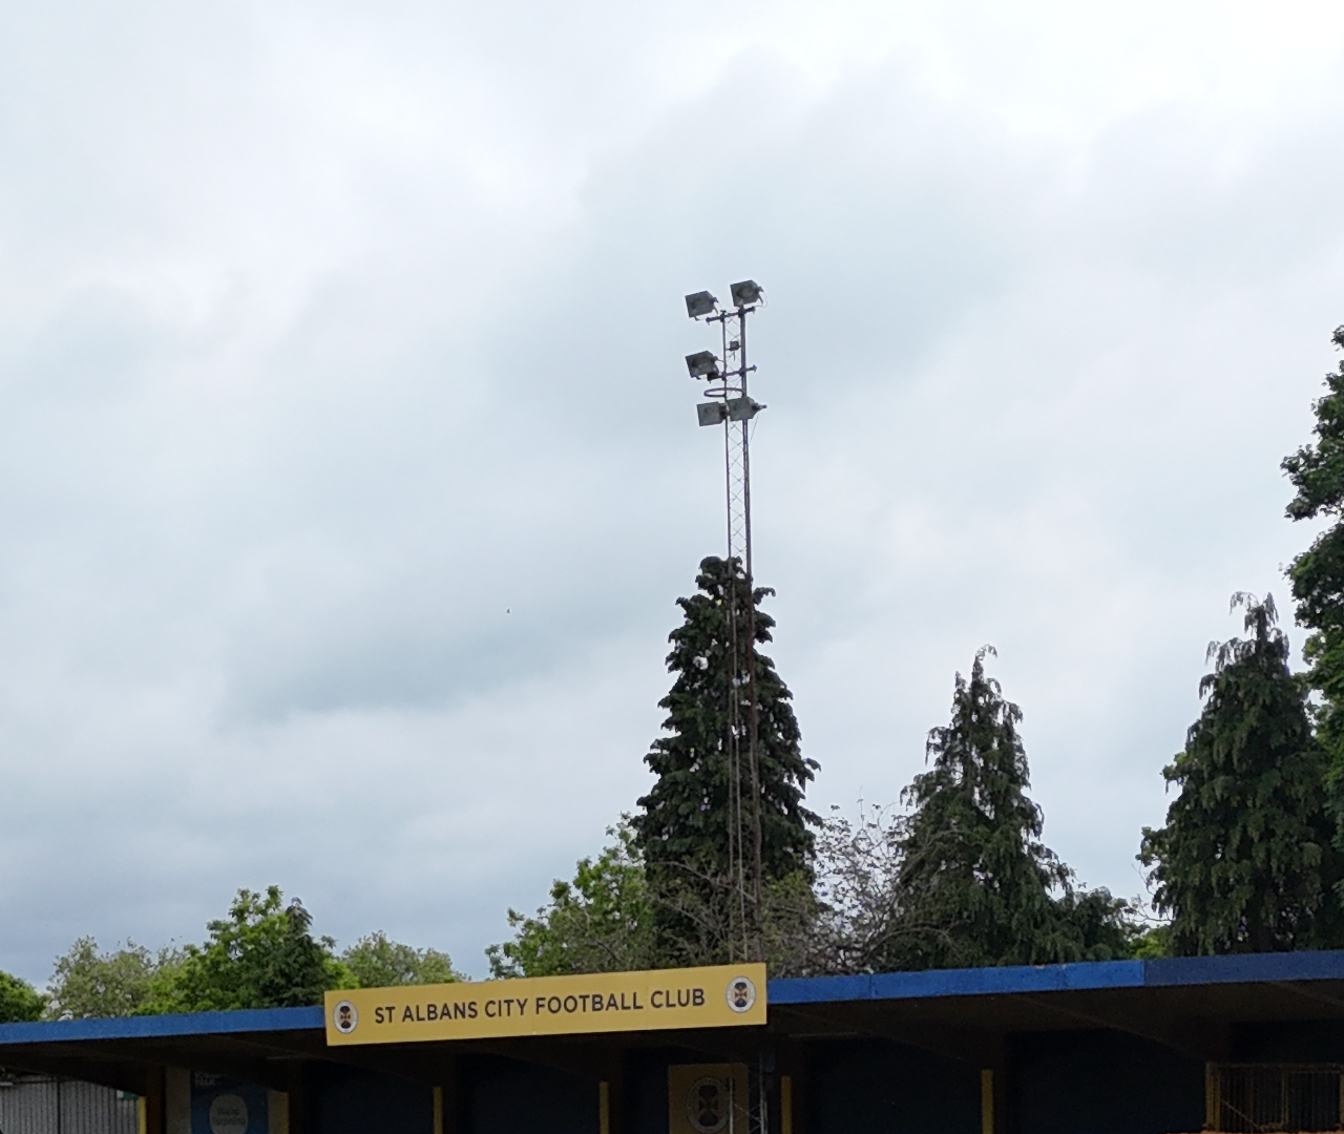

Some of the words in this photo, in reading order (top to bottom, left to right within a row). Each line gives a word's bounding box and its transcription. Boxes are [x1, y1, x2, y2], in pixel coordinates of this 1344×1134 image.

[374, 1006, 396, 1024] ST
[402, 1001, 478, 1022] ALBANS
[484, 998, 528, 1018] CITY
[535, 991, 644, 1015] FOOTBALL
[650, 988, 706, 1009] CLUB
